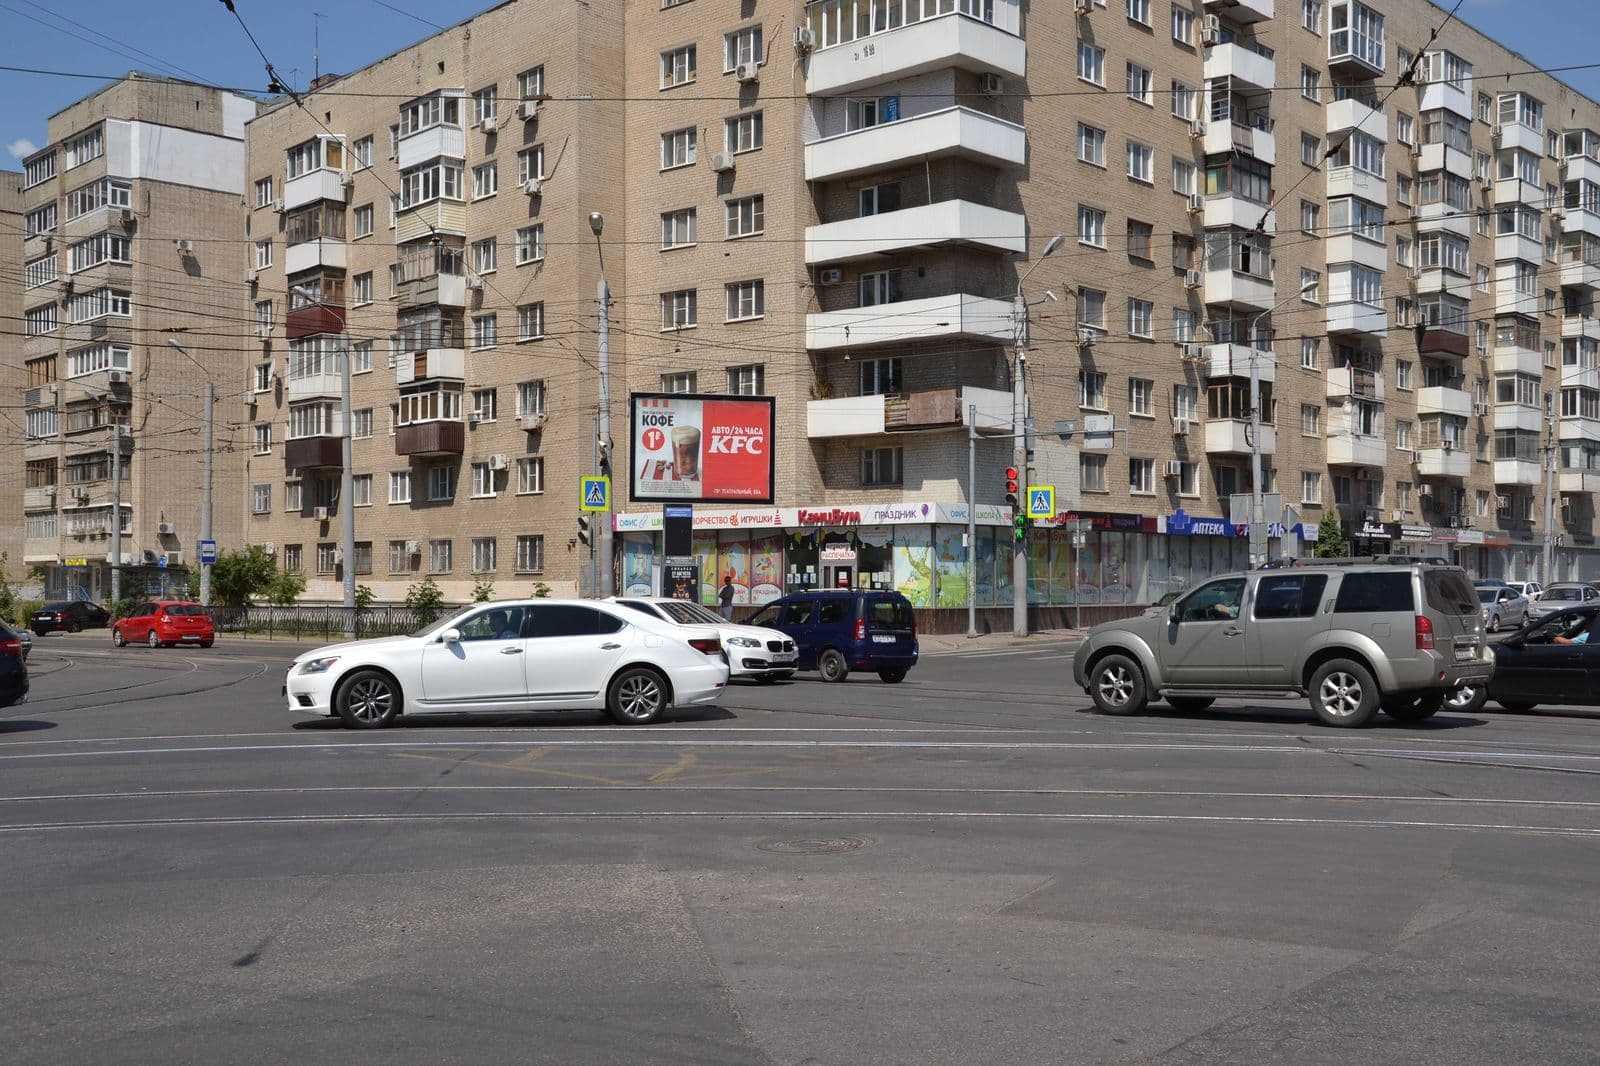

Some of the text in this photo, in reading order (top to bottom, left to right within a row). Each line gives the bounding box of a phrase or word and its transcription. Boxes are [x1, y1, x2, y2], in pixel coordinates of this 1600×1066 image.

[642, 414, 674, 427] КОФЕ
[711, 425, 764, 436] АВТО/24 ЧАСА
[708, 435, 764, 455] KFC
[740, 515, 773, 525] ИГРУШКИ
[797, 508, 861, 526] КанцБум
[874, 510, 917, 521] ПРАЗДНИК
[950, 510, 967, 519] ОФИС
[975, 510, 995, 520] ШКОЛА
[619, 519, 638, 528] ОФИС
[1192, 523, 1225, 536] АПТЕКА
